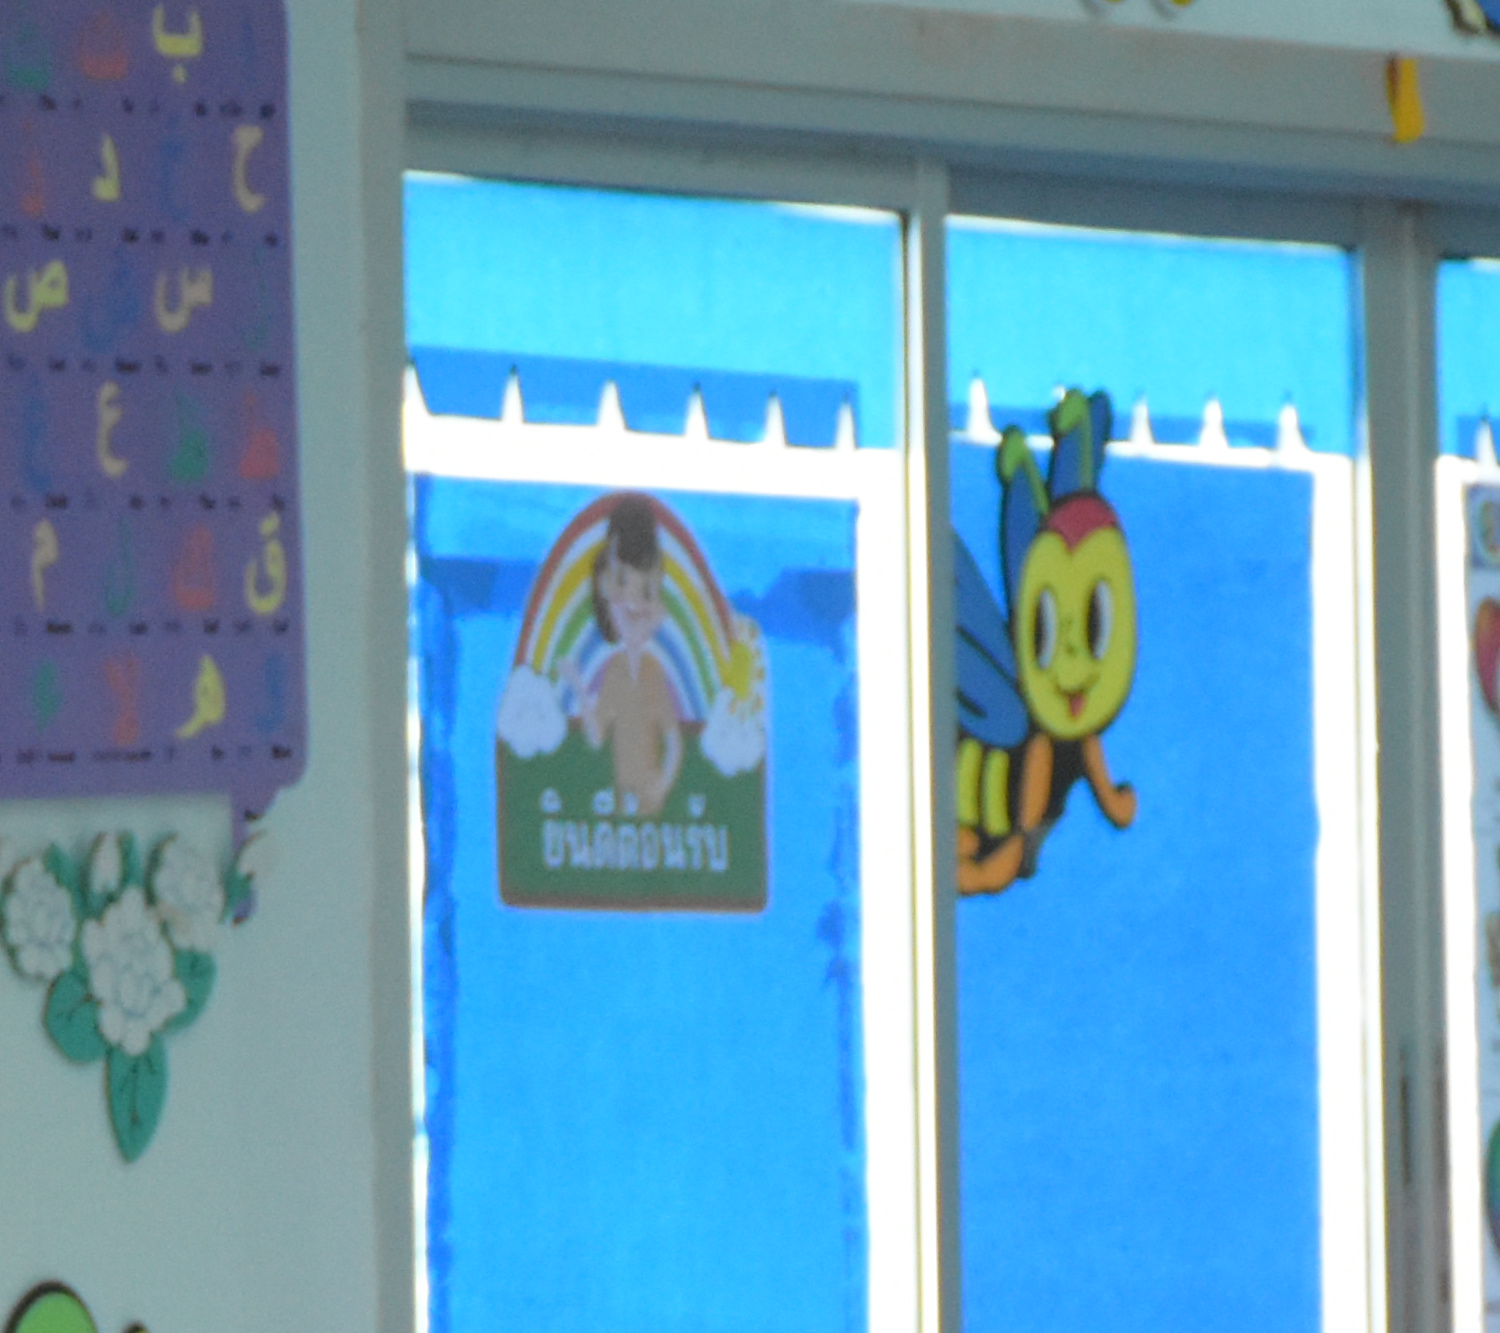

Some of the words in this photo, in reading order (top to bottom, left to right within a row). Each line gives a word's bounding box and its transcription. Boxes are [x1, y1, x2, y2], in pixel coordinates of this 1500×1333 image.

[152, 3, 204, 83] ب
[92, 132, 120, 202] د
[232, 124, 265, 213] ح
[3, 257, 69, 334] ص
[155, 262, 214, 334] س
[96, 381, 127, 477] ع
[30, 518, 60, 613] م
[244, 511, 287, 616] ق
